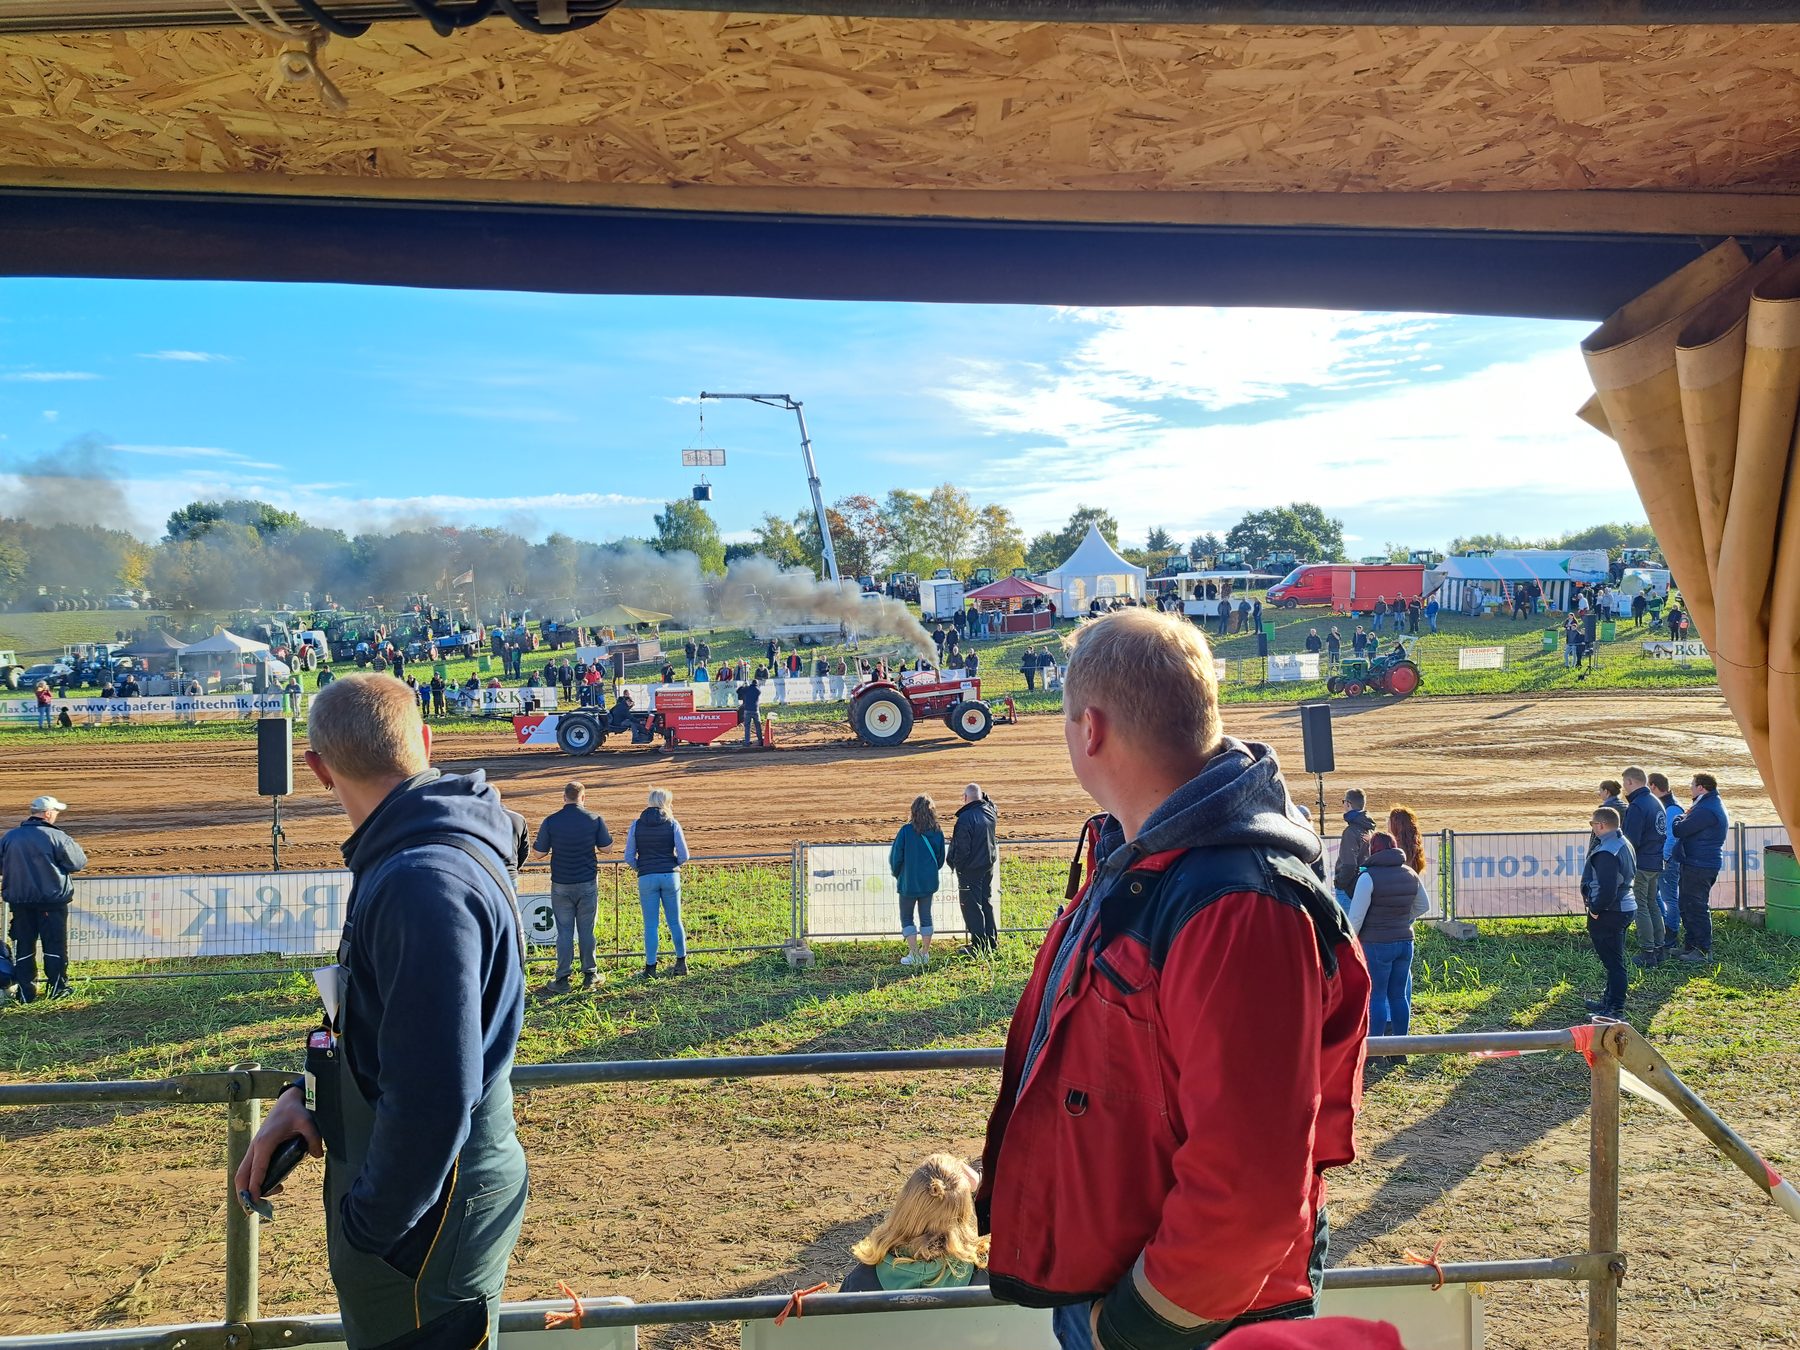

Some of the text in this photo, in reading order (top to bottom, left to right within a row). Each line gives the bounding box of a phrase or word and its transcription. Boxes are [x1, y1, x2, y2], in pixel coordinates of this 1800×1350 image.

[483, 690, 521, 704] B&K
[21, 701, 61, 713] Schfe
[73, 699, 281, 712] www.schaefer-landtechnik.com
[533, 905, 555, 932] 3
